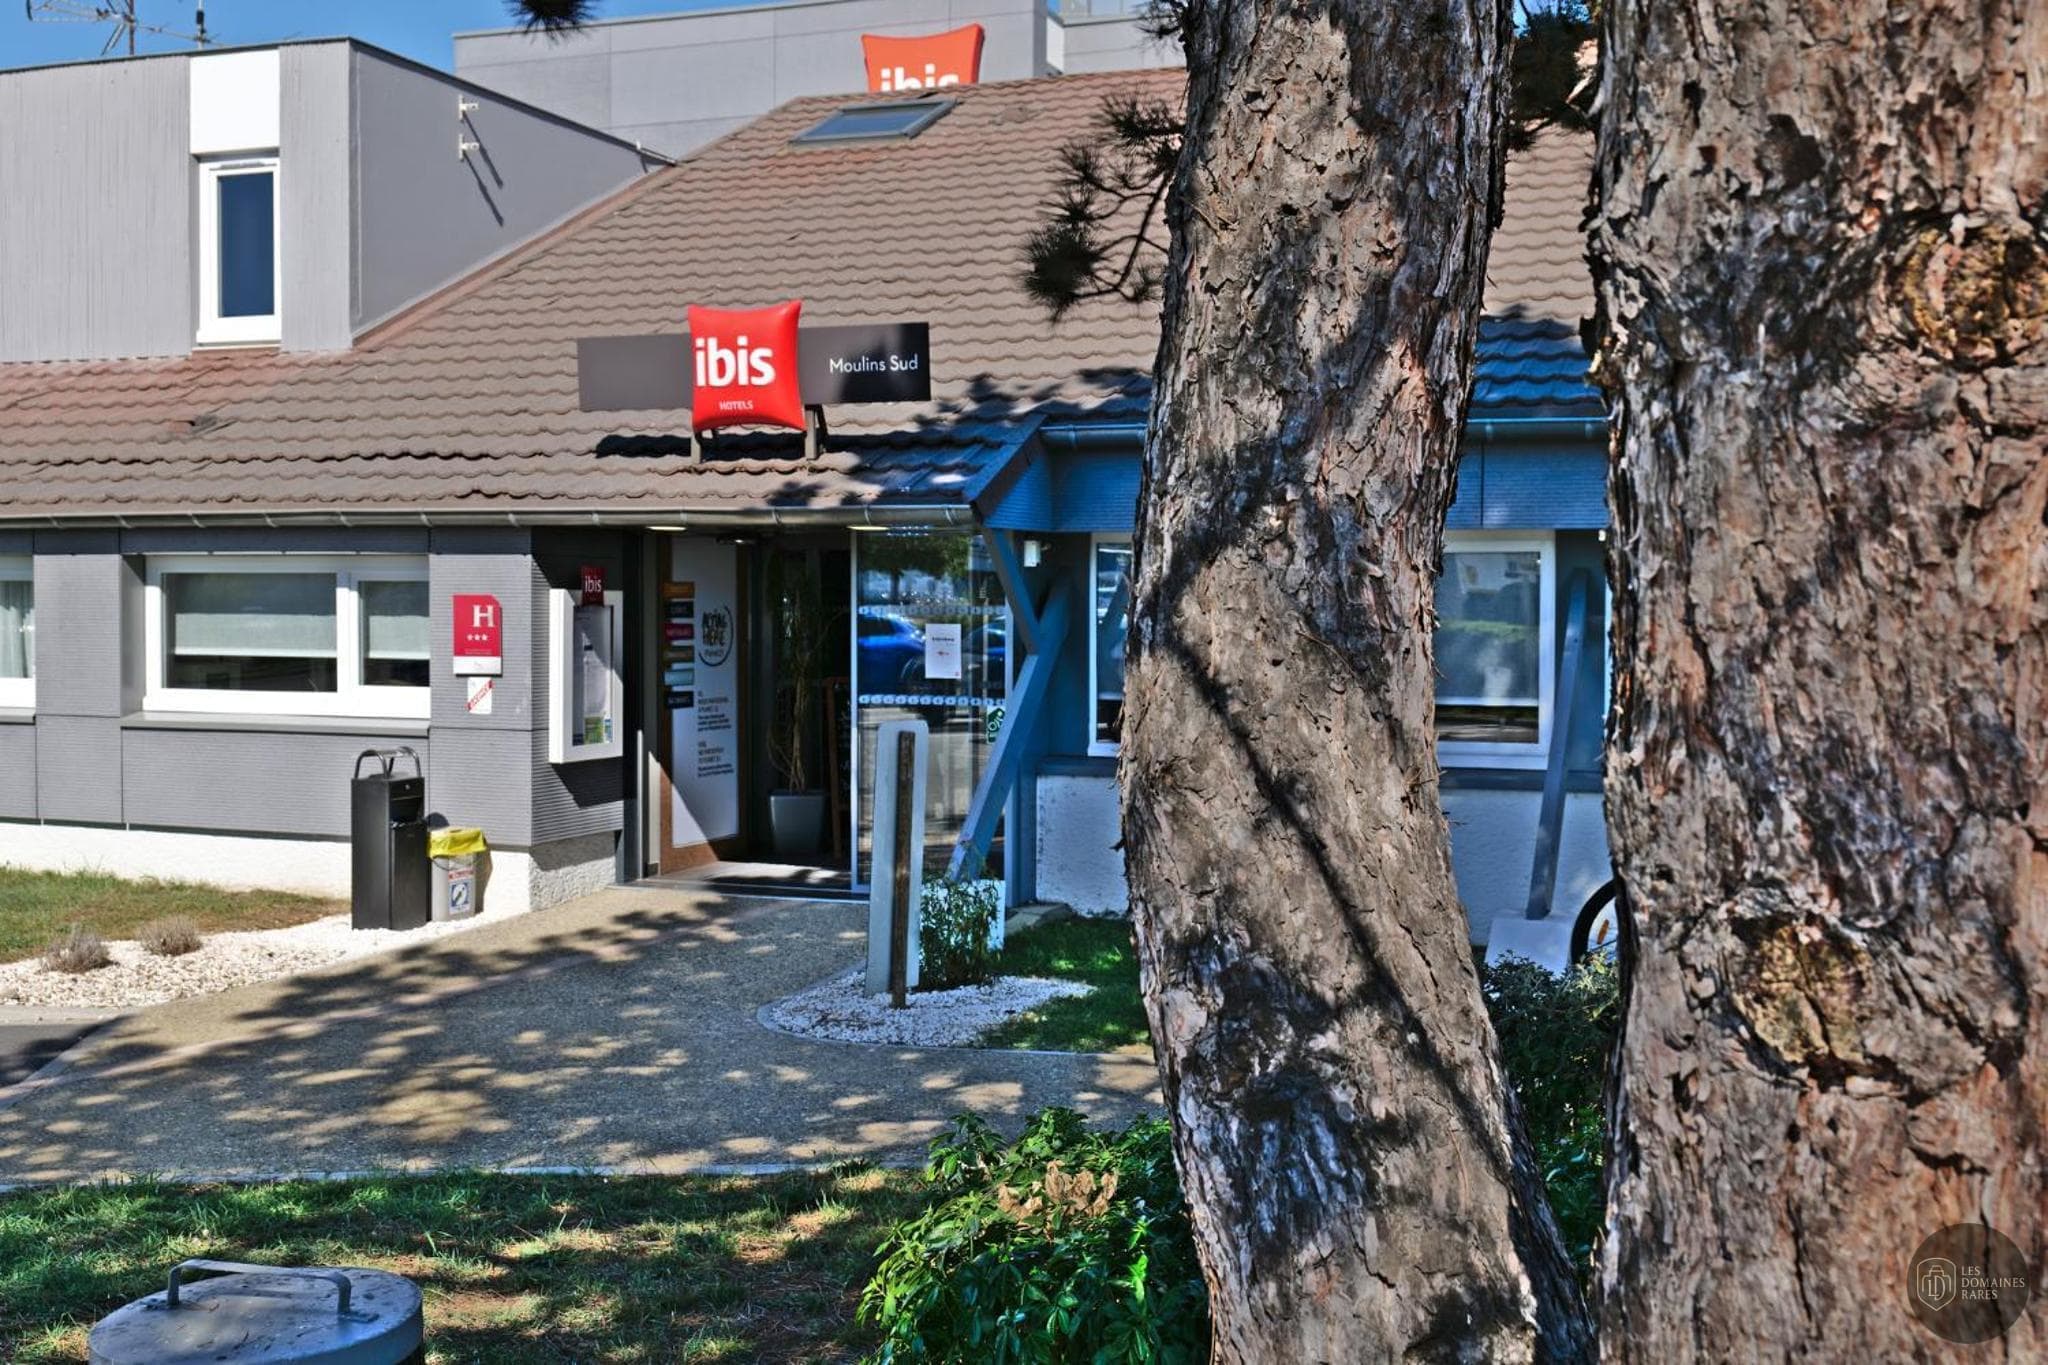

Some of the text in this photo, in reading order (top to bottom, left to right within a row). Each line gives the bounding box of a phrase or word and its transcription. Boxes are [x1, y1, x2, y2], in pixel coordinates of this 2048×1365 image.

[881, 63, 959, 92] ii
[695, 335, 776, 387] ibis
[829, 353, 919, 374] Moulins Sud
[719, 400, 753, 410] HOTELS
[585, 575, 602, 593] ibis
[472, 604, 495, 628] H
